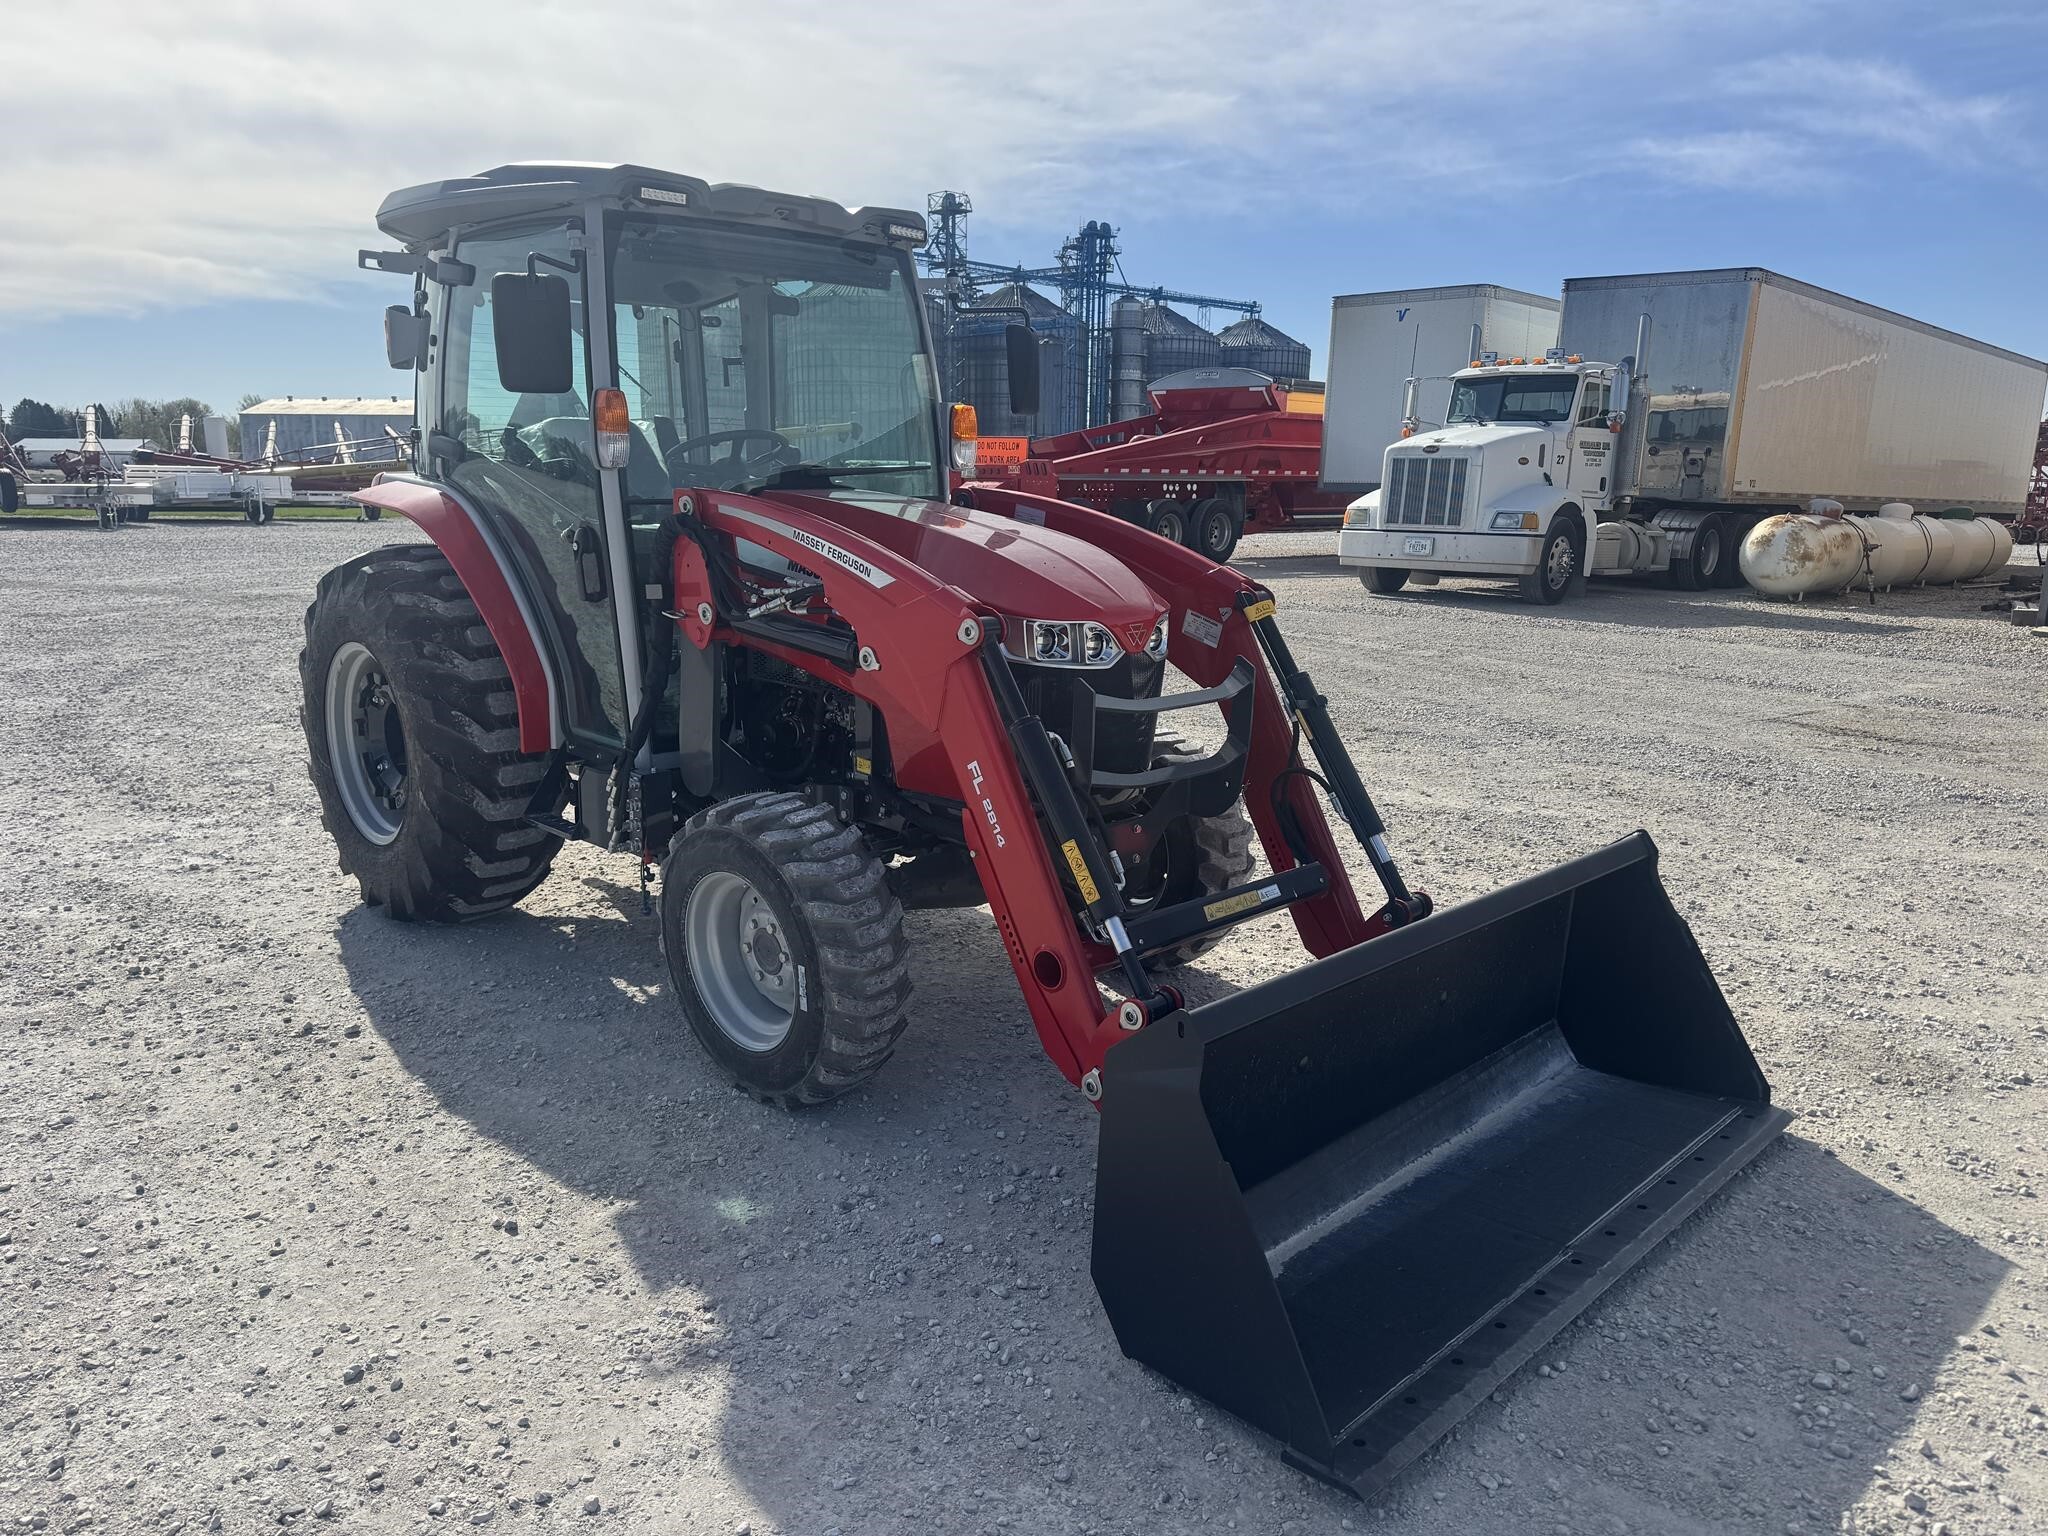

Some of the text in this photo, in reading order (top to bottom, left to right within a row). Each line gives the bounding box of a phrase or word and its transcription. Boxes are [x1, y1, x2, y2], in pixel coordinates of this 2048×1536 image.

[978, 442, 1020, 451] DO NOT FOLLOW
[990, 456, 1005, 464] WORK
[1006, 456, 1020, 465] AREA
[1556, 455, 1565, 465] 27
[792, 530, 872, 578] MASSEY FERGUSON
[967, 760, 1006, 848] FL 2814
